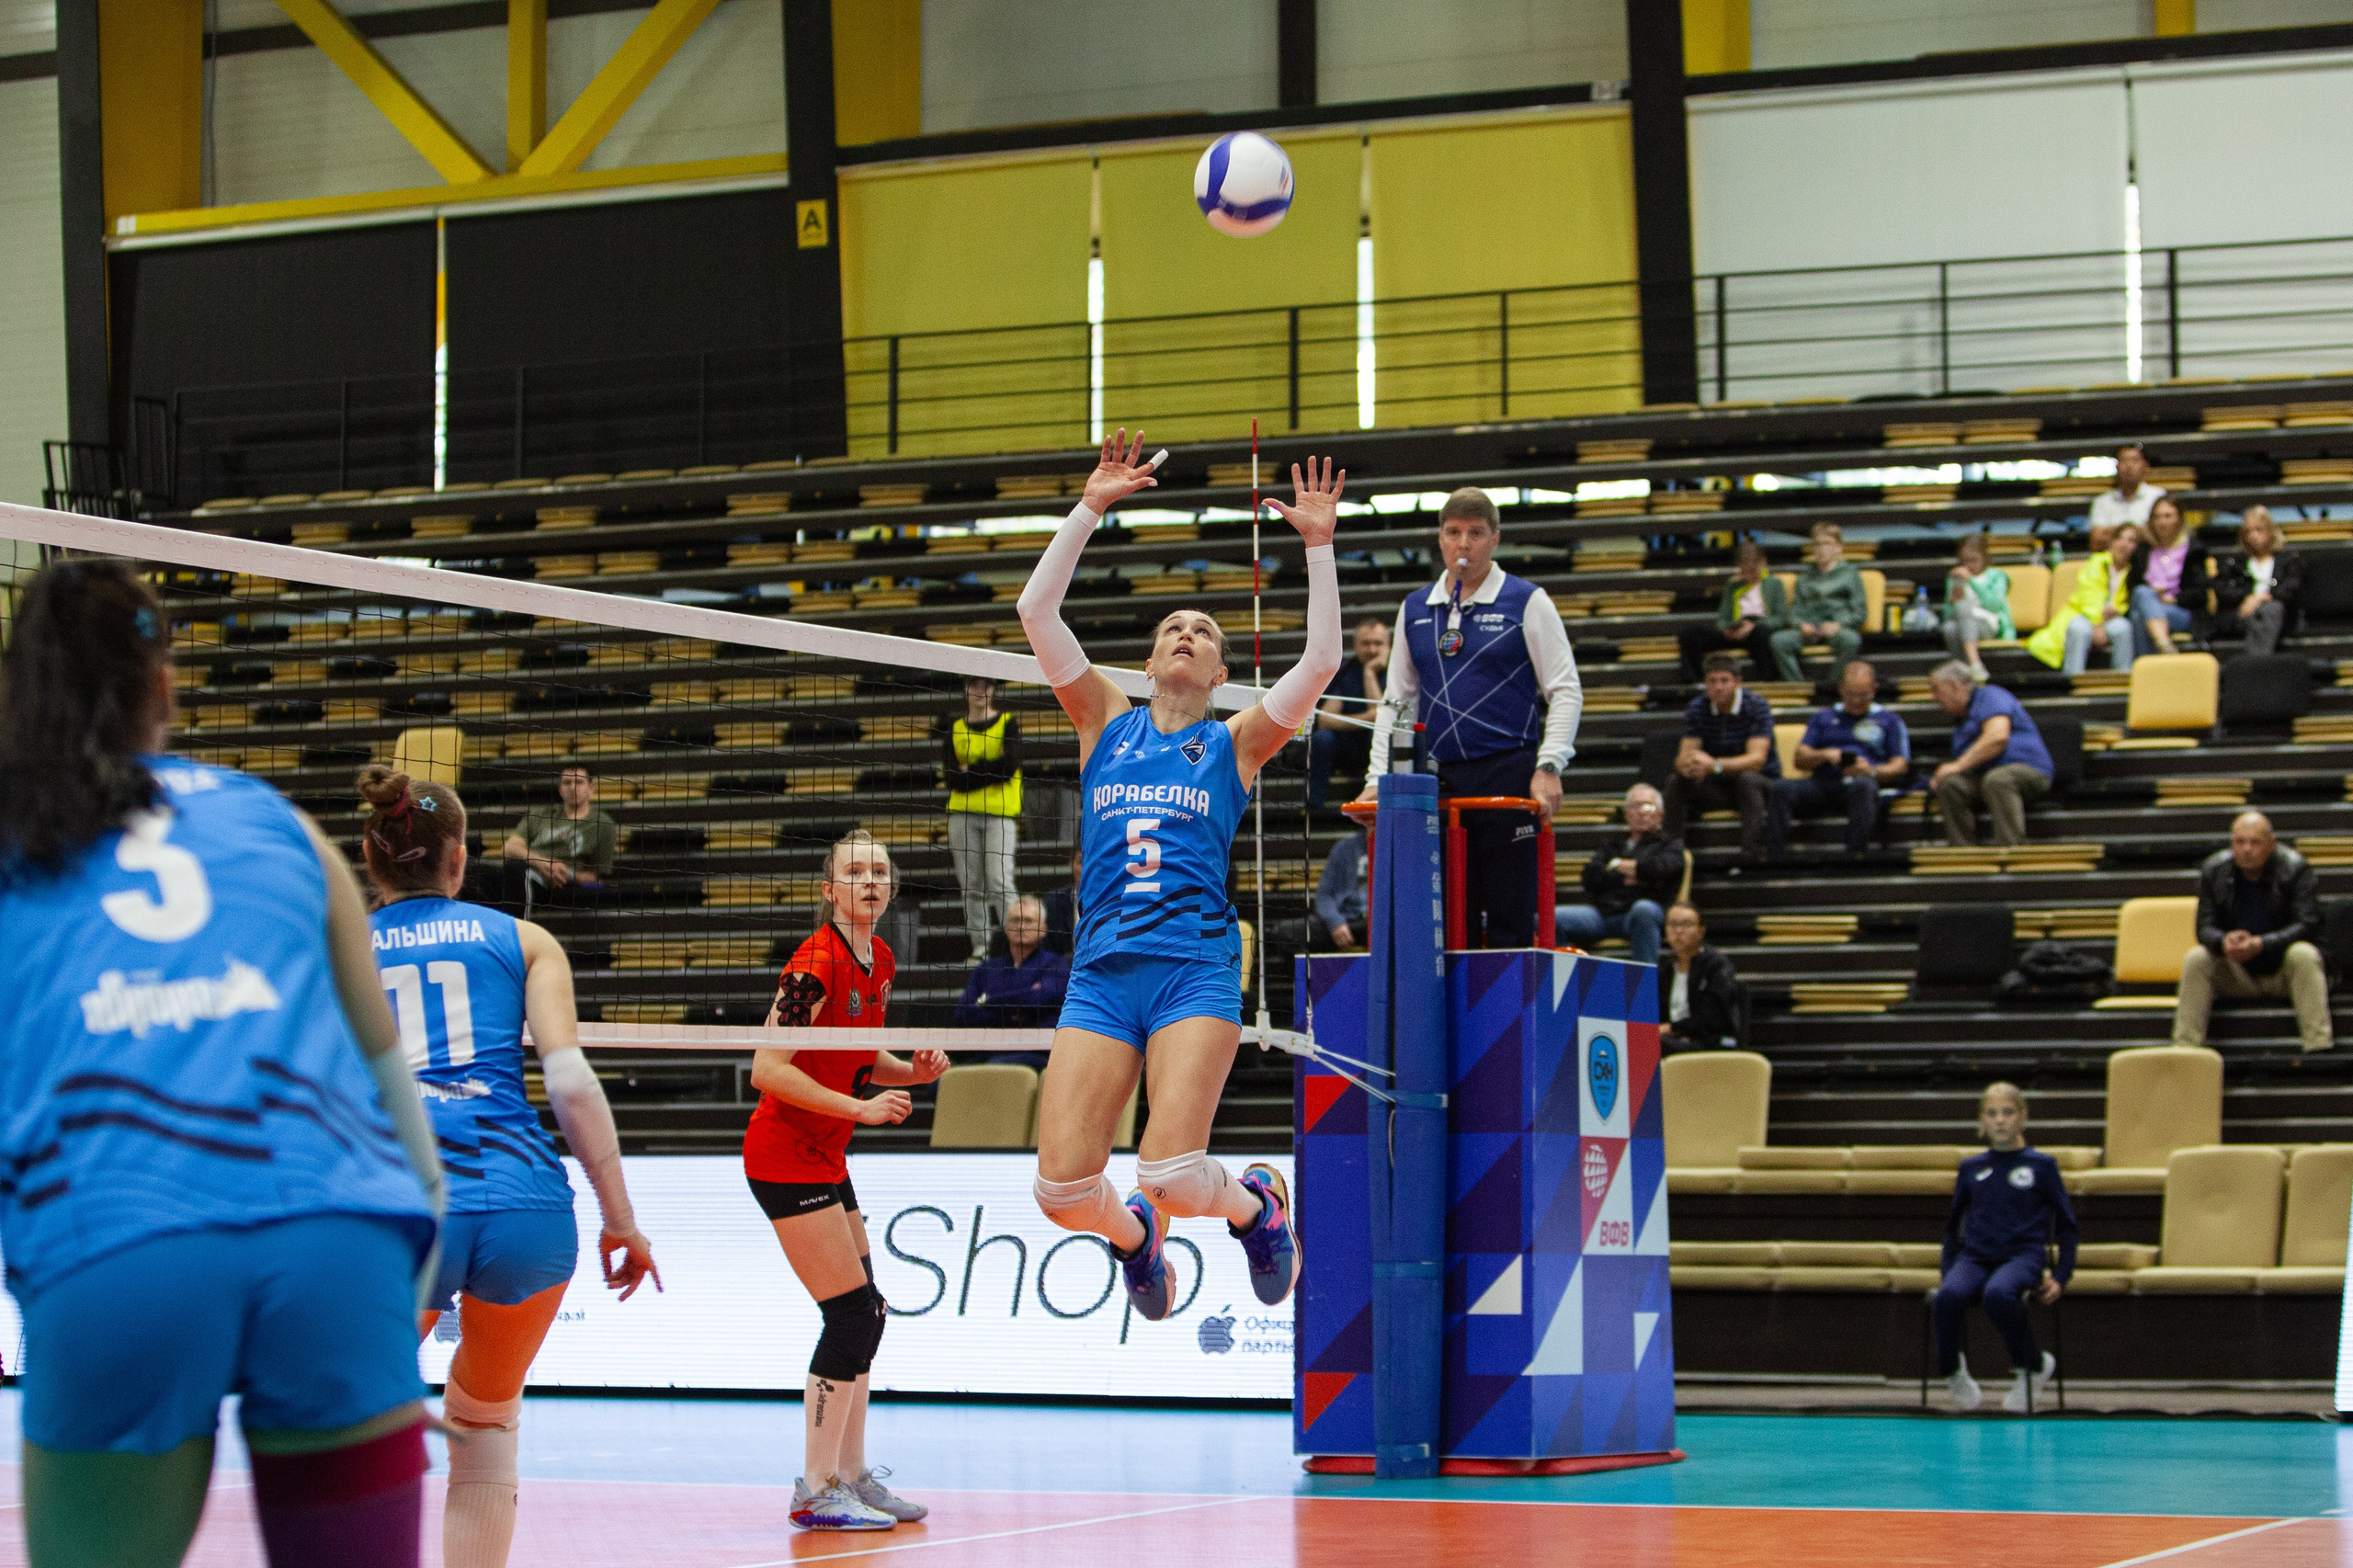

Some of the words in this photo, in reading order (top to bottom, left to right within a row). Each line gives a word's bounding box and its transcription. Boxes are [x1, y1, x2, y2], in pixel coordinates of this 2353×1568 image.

[802, 209, 822, 231] A
[1093, 783, 1210, 817] КОРАБЕЛКА
[1101, 806, 1194, 823] САНКТ-ПЕТЕРБУРГ
[1125, 818, 1162, 879] 5
[371, 920, 485, 952] АЛЬШИНА
[381, 960, 476, 1073] 11
[1599, 1221, 1630, 1246] ВФВ
[861, 1205, 1205, 1345] Shop
